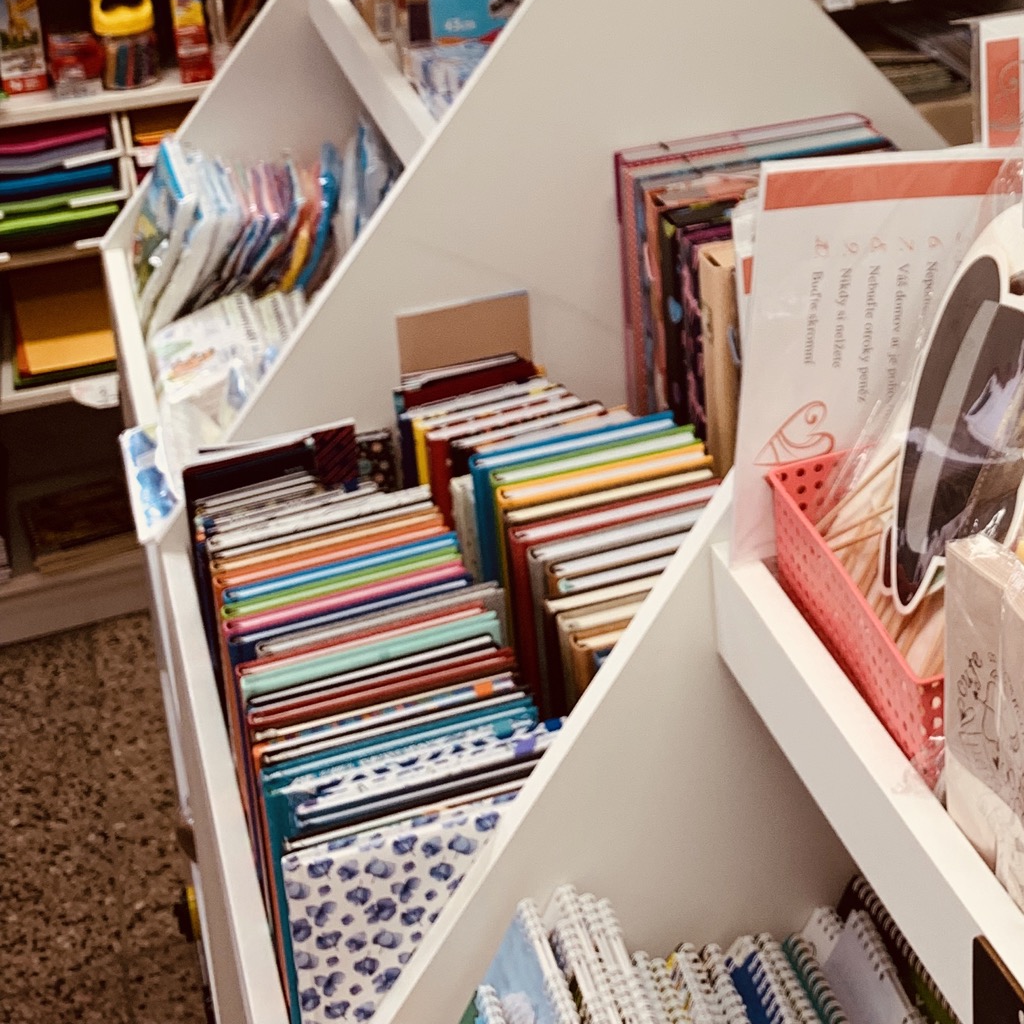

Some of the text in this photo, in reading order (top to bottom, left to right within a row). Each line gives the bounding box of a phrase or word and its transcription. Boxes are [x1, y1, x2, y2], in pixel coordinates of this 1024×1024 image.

[835, 267, 853, 307] Nikdy
[892, 290, 908, 333] domov
[803, 312, 819, 366] skromní
[859, 322, 875, 363] otroky
